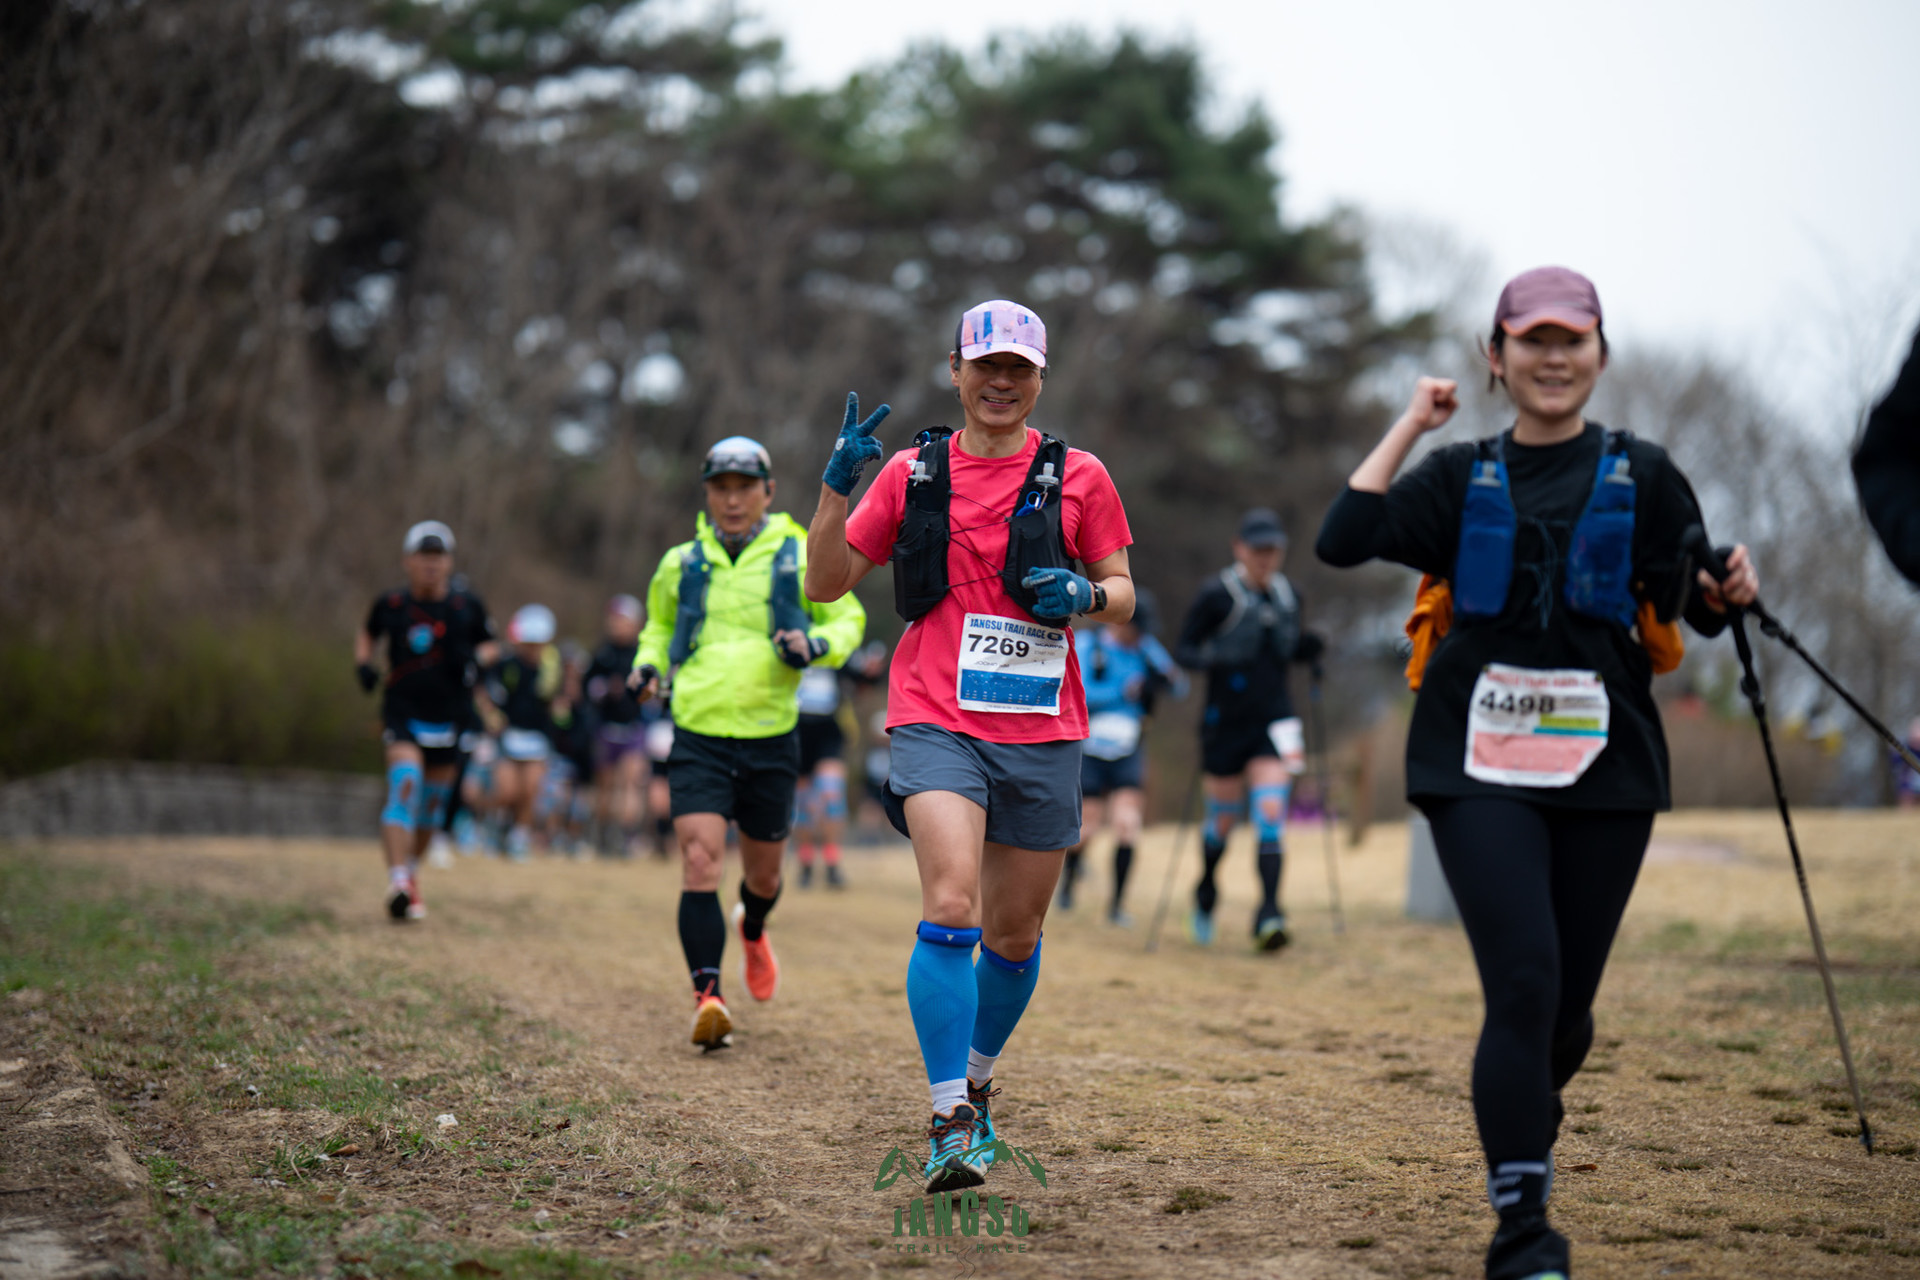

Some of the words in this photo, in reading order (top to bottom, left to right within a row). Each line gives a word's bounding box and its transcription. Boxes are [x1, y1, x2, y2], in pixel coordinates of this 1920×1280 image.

[969, 618, 1003, 631] JANGSU
[1004, 622, 1026, 635] TRAIL
[1026, 627, 1046, 639] RACE
[967, 633, 1030, 658] 7269
[1479, 688, 1556, 715] 4498
